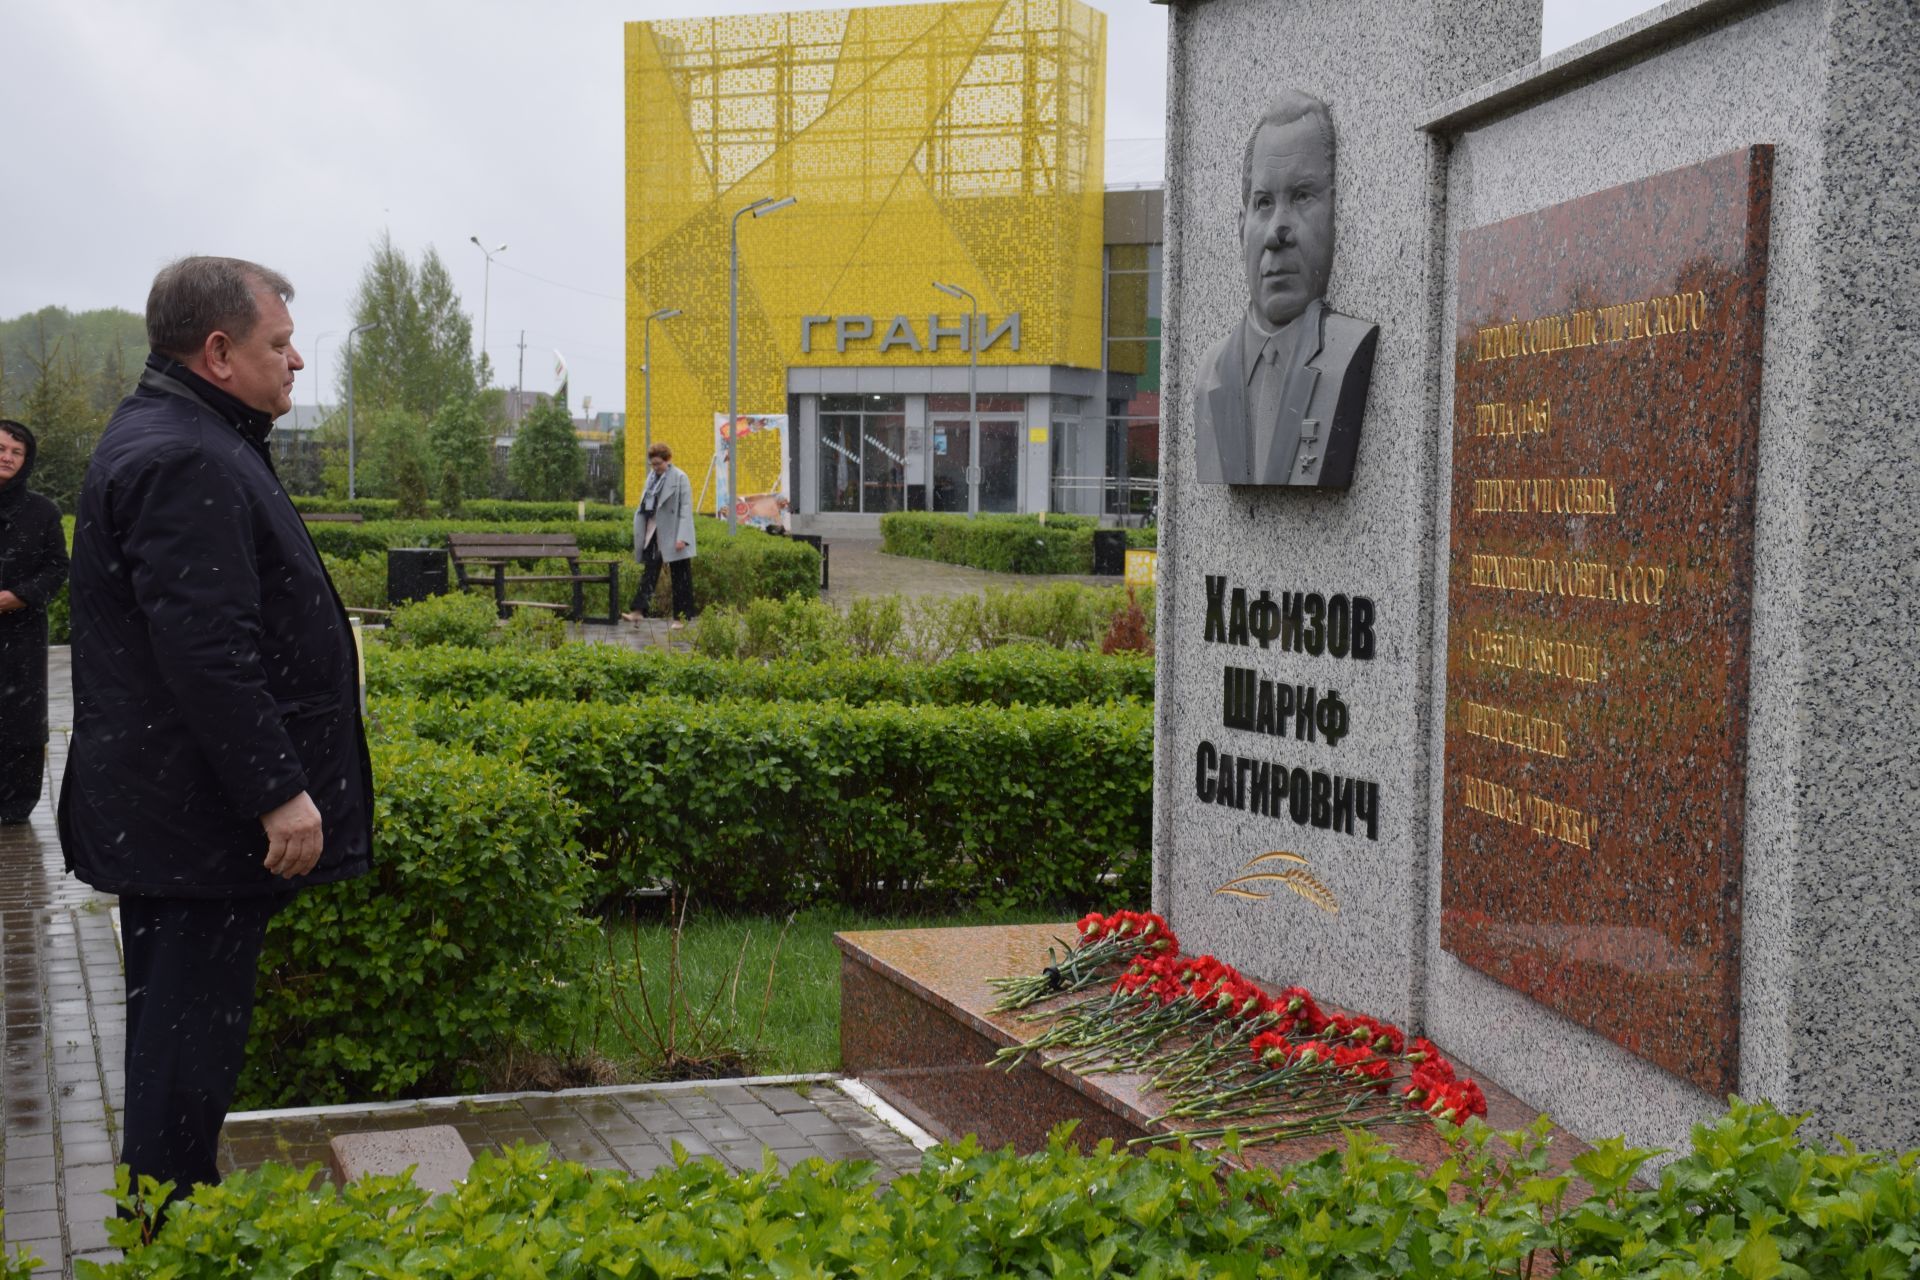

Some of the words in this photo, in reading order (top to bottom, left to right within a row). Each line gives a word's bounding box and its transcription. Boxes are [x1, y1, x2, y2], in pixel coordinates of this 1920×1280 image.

[802, 313, 1021, 353] ГРАНИ
[1478, 313, 1519, 362] ГЕРОЙ
[1521, 290, 1706, 355] СОЦИАЛИСТИЧЕСКОГО
[1475, 403, 1515, 442] ТРУДА
[1473, 479, 1530, 517] ДЕПУТАТ
[1555, 478, 1616, 515] СОЗЫВА
[1471, 553, 1555, 595] ВЕРХОВНОГО
[1558, 561, 1617, 600] СОВЕТА
[1621, 565, 1665, 605] СССР
[1204, 575, 1376, 660] ХАФИЗОВ
[1469, 629, 1479, 661] С
[1506, 633, 1526, 670] ПО
[1556, 642, 1600, 687] ГОДЫ
[1223, 666, 1349, 747] ШАРИФ
[1467, 700, 1567, 758] ПРЕДСЕДАТЕЛЬ
[1196, 740, 1380, 841] САГИРОВИЧ
[1465, 774, 1522, 826] КОЛХОЗА
